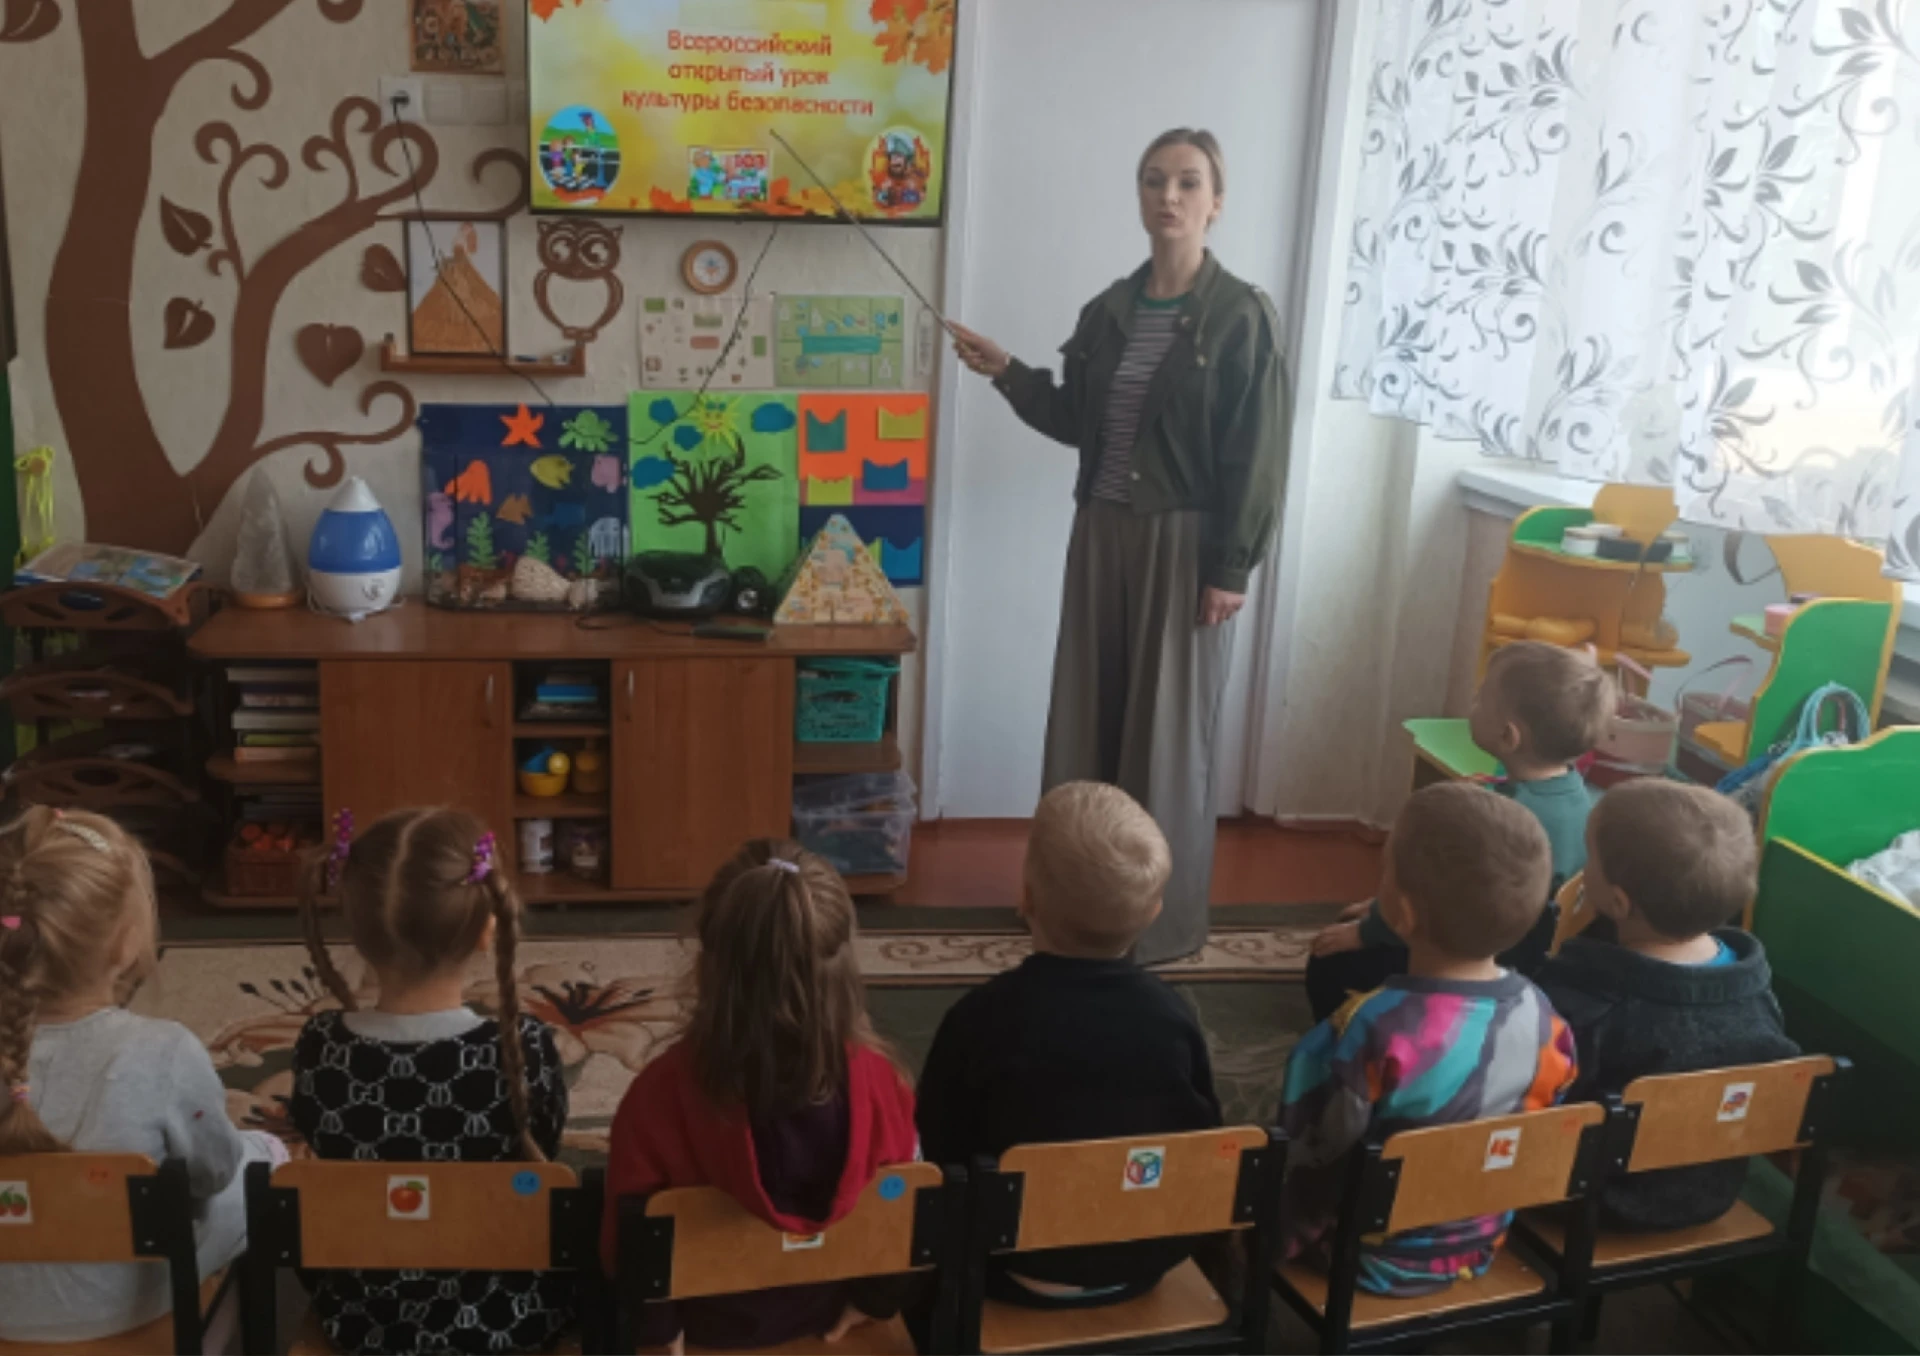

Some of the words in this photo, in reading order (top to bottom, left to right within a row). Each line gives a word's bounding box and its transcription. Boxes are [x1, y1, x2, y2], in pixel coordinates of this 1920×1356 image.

[667, 29, 832, 56] Всероссийский
[668, 62, 774, 84] открытый
[779, 67, 829, 88] урок
[622, 90, 721, 112] культуры
[727, 88, 874, 116] безопасности
